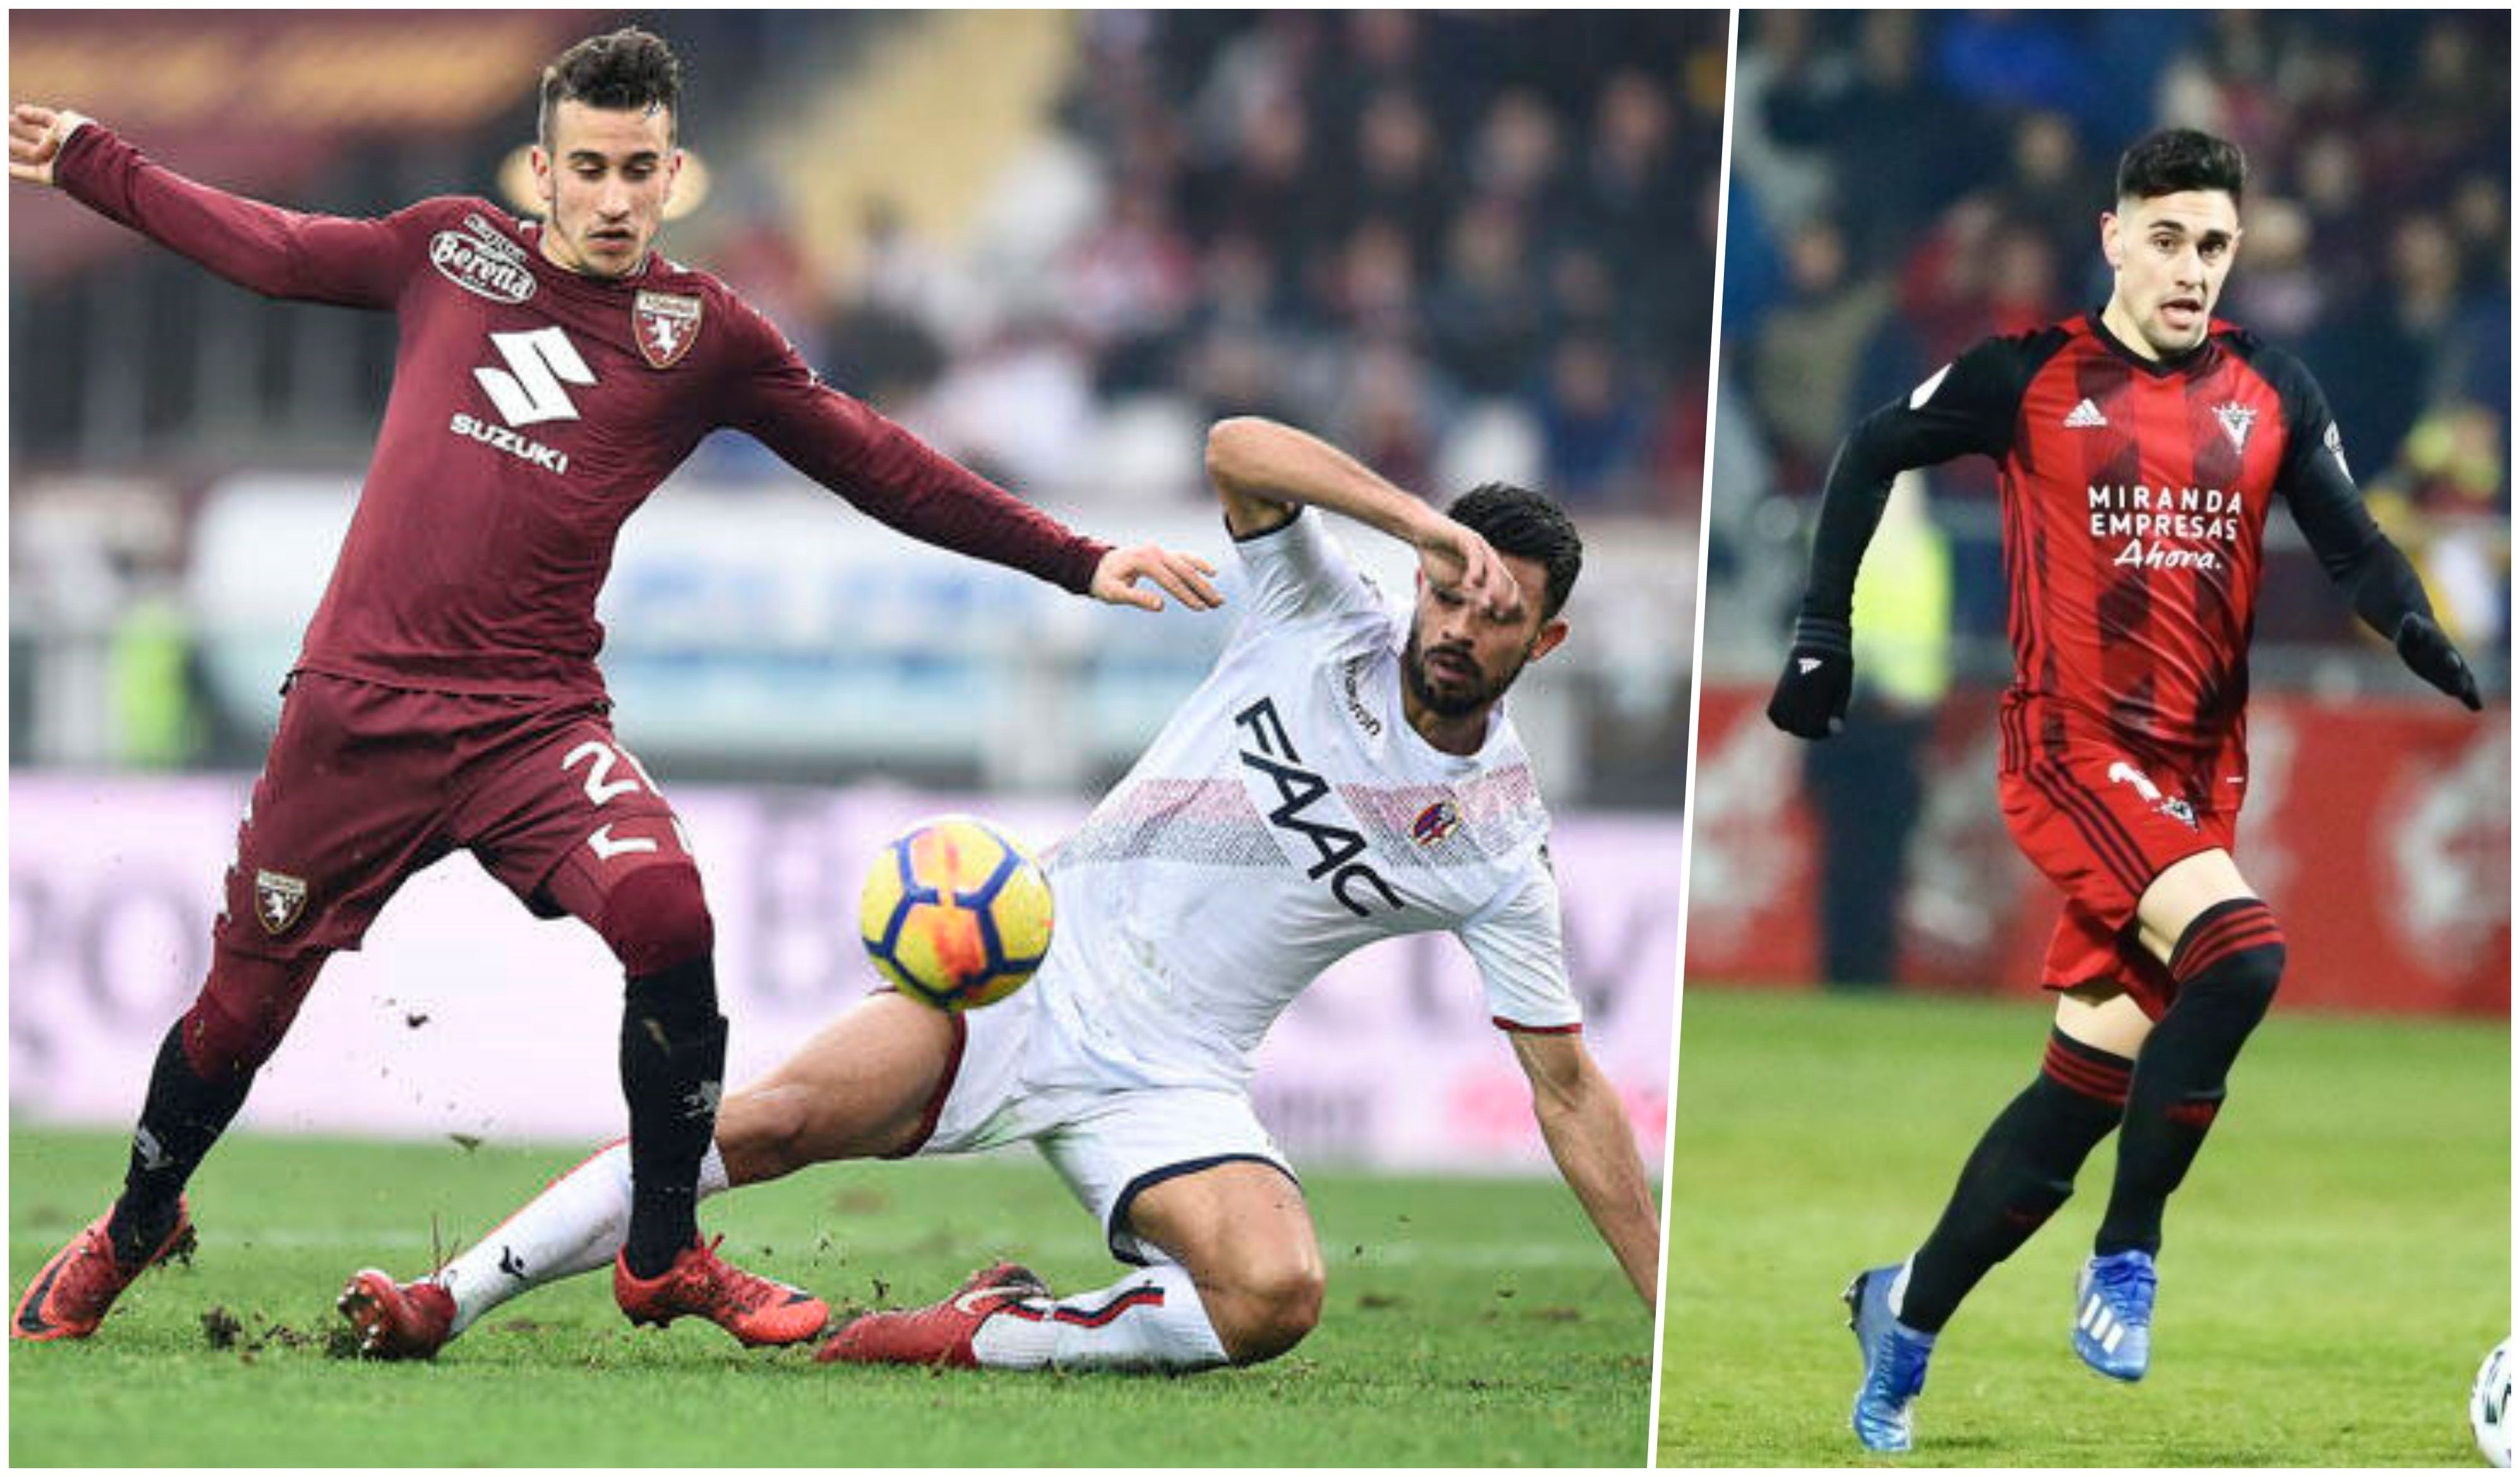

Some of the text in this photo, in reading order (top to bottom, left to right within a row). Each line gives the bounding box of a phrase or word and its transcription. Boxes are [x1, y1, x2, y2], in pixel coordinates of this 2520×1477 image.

[436, 234, 532, 299] Beretta
[449, 413, 568, 474] SUZUKI
[2088, 485, 2242, 515] MIRANDA
[2091, 513, 2238, 541] EMPRESAS
[2113, 538, 2222, 570] Ahora.
[1235, 697, 1406, 918] FAAC
